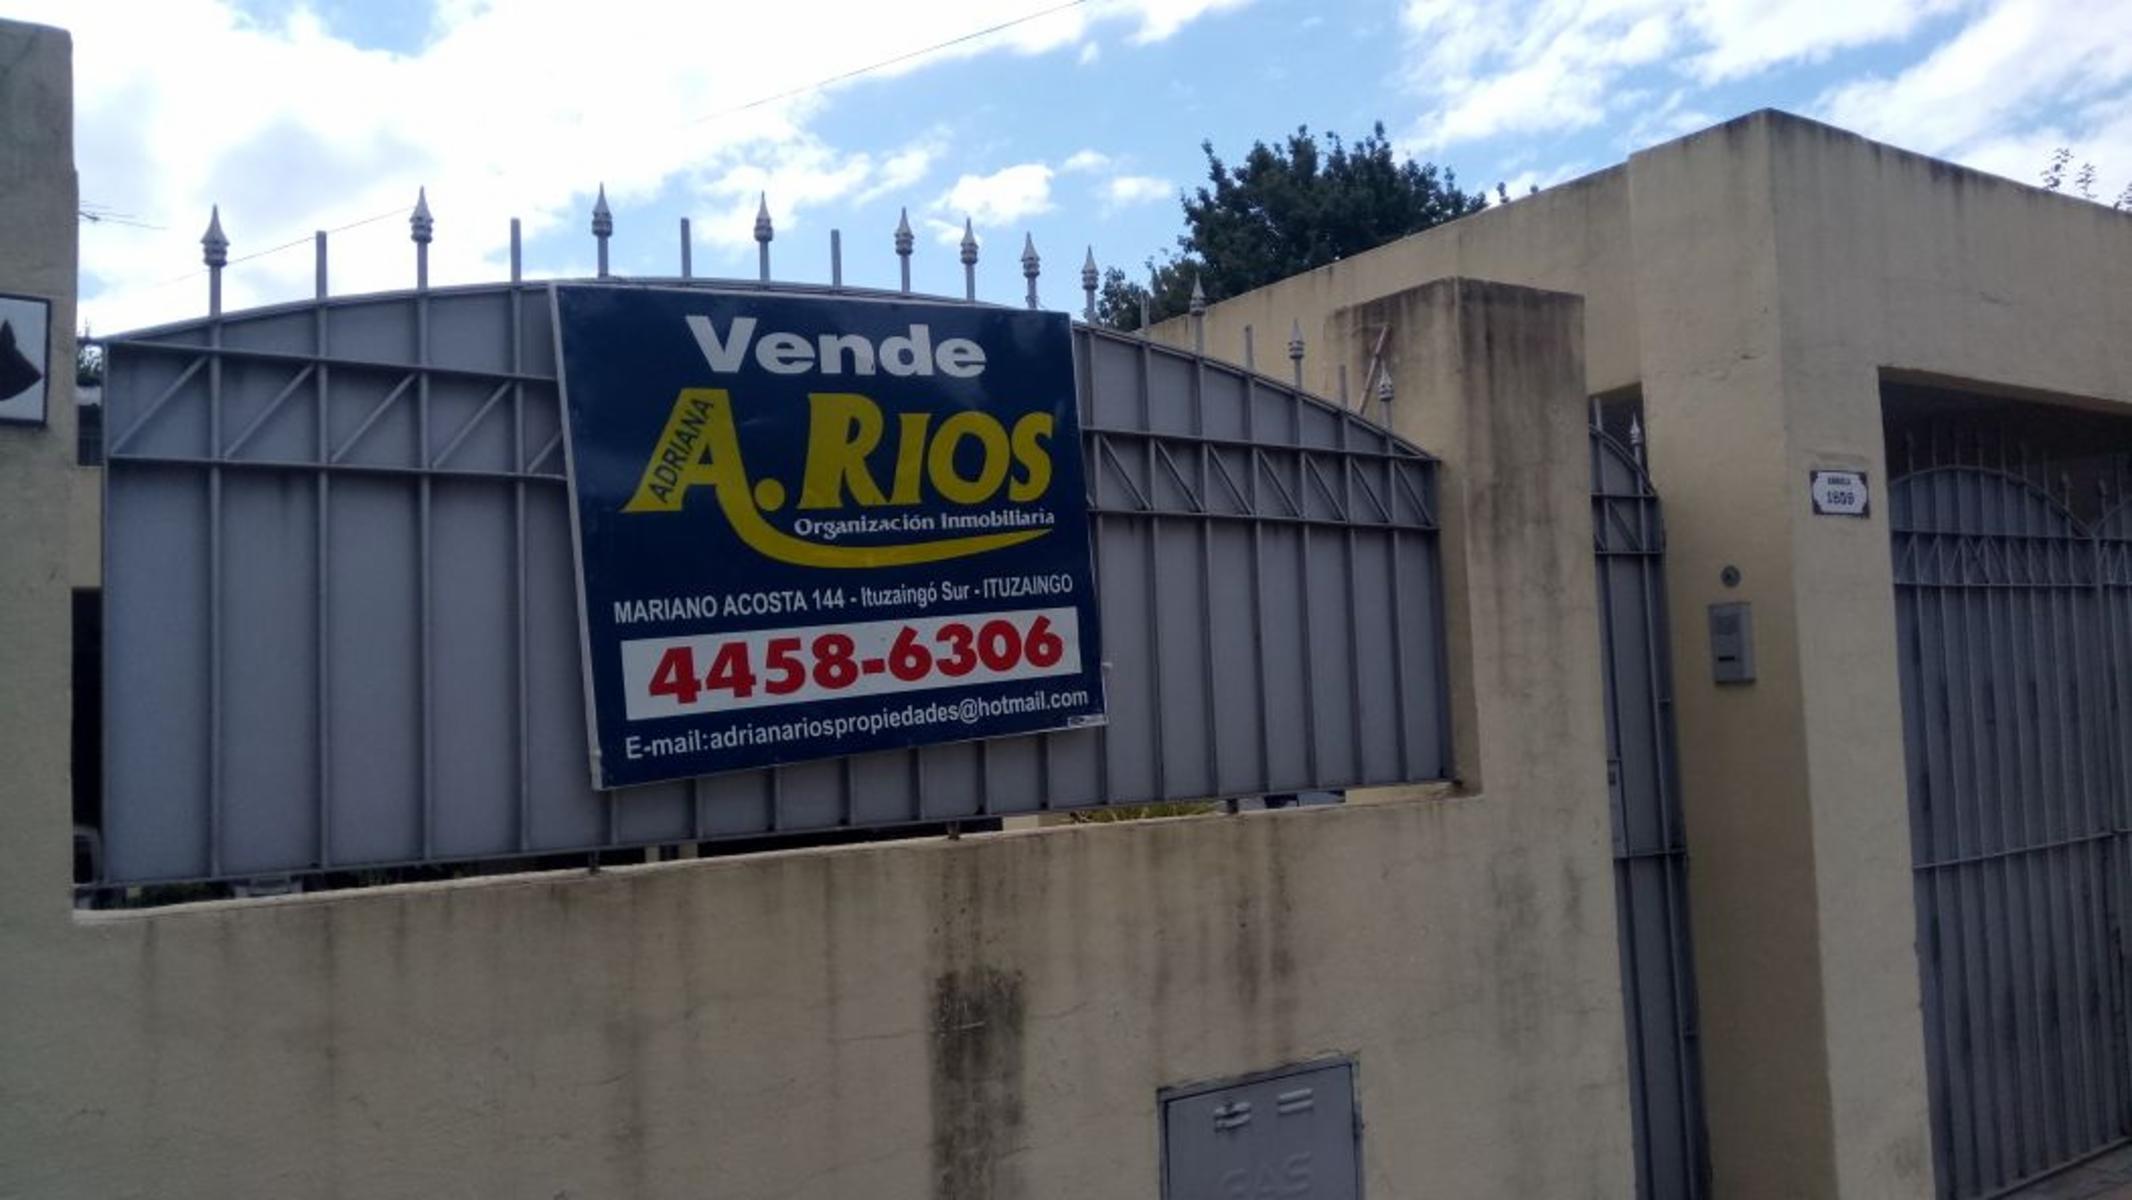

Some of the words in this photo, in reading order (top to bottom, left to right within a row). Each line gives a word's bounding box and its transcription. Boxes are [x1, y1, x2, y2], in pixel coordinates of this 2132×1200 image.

[685, 314, 986, 378] Vende
[646, 395, 715, 504] ADRIANA
[793, 514, 935, 540] Organización
[940, 507, 1055, 530] Inmobiliaria
[613, 595, 718, 624] MARIANO
[723, 590, 808, 617] ACOSTA
[812, 586, 844, 610] 144
[861, 581, 937, 608] Ituzaingó
[941, 581, 970, 601] Sur
[983, 573, 1073, 599] ITUZAINGO
[648, 614, 1064, 704] 4458-6306
[625, 689, 1088, 760] E-mail:adrianariospropiedades@hotmail.com
